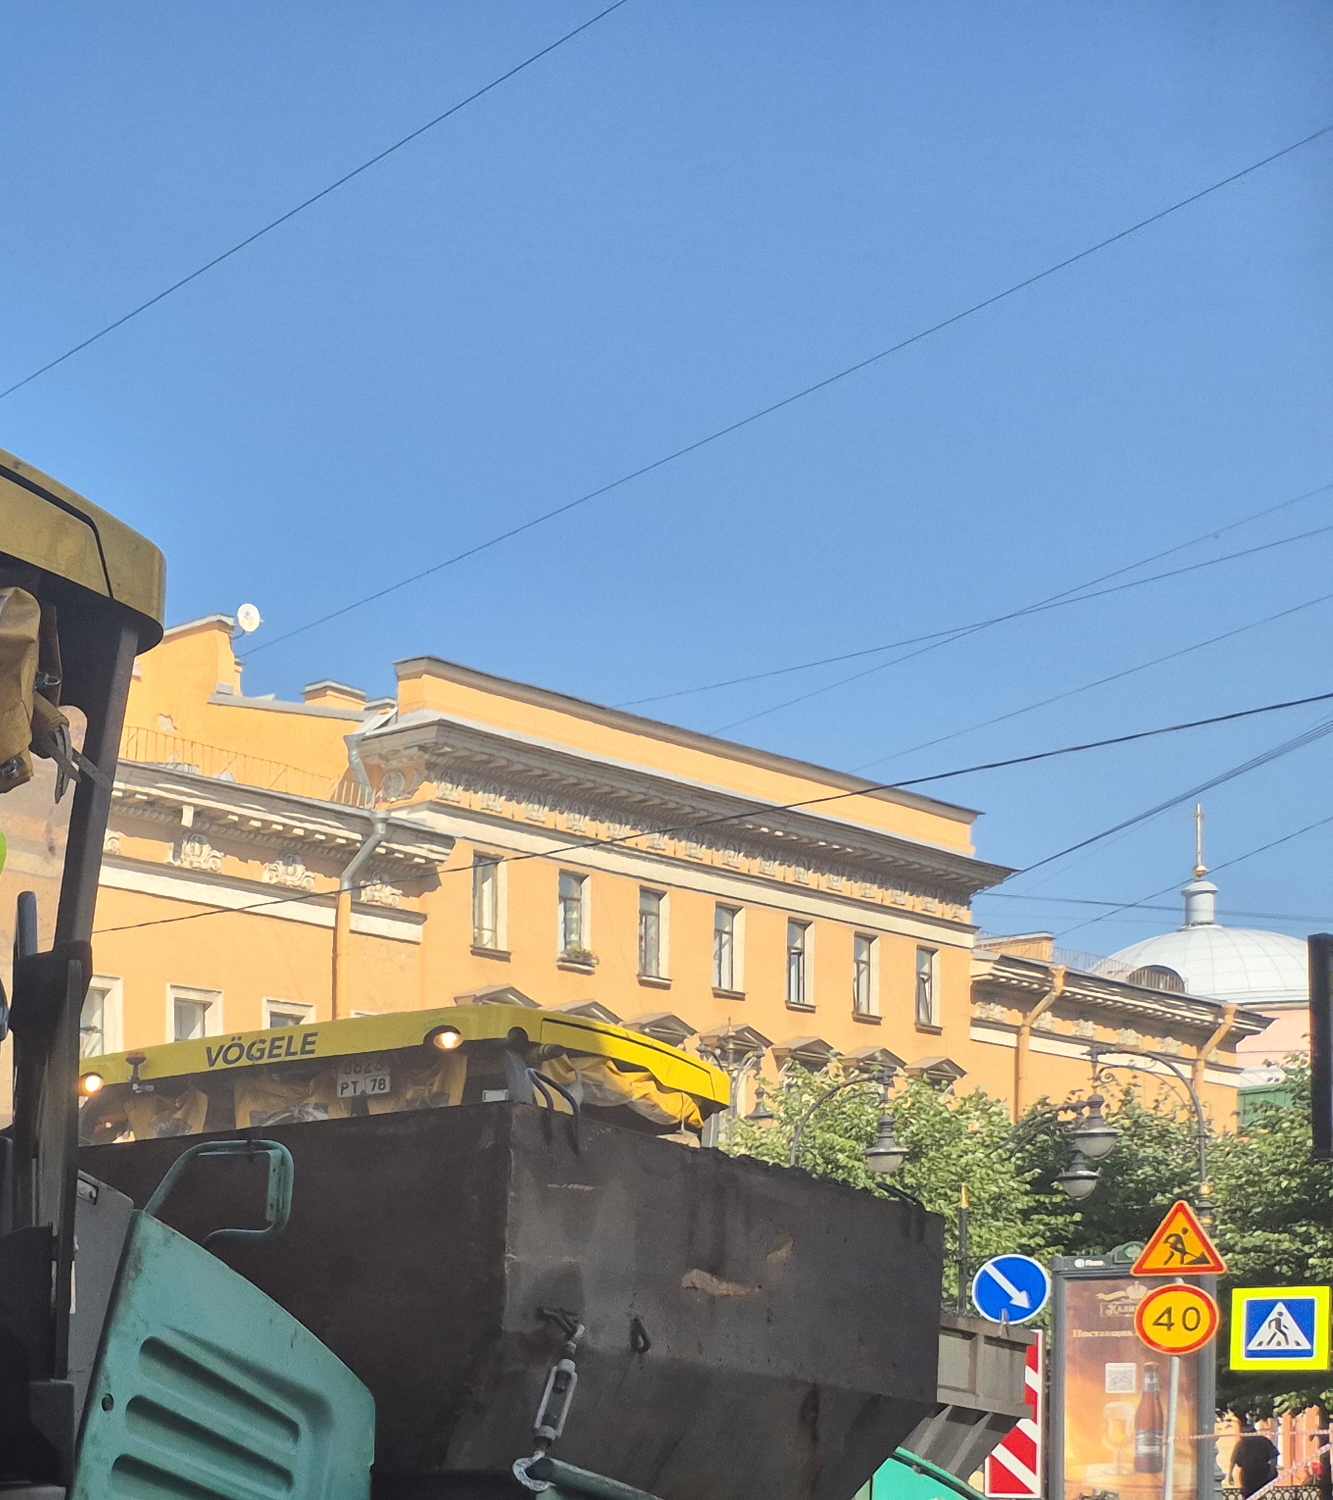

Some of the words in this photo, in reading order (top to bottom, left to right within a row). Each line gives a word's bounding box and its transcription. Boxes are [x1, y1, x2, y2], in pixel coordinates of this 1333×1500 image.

[205, 1031, 319, 1067] VÖGELE
[370, 1077, 386, 1092] 78
[1151, 1306, 1202, 1332] 40
